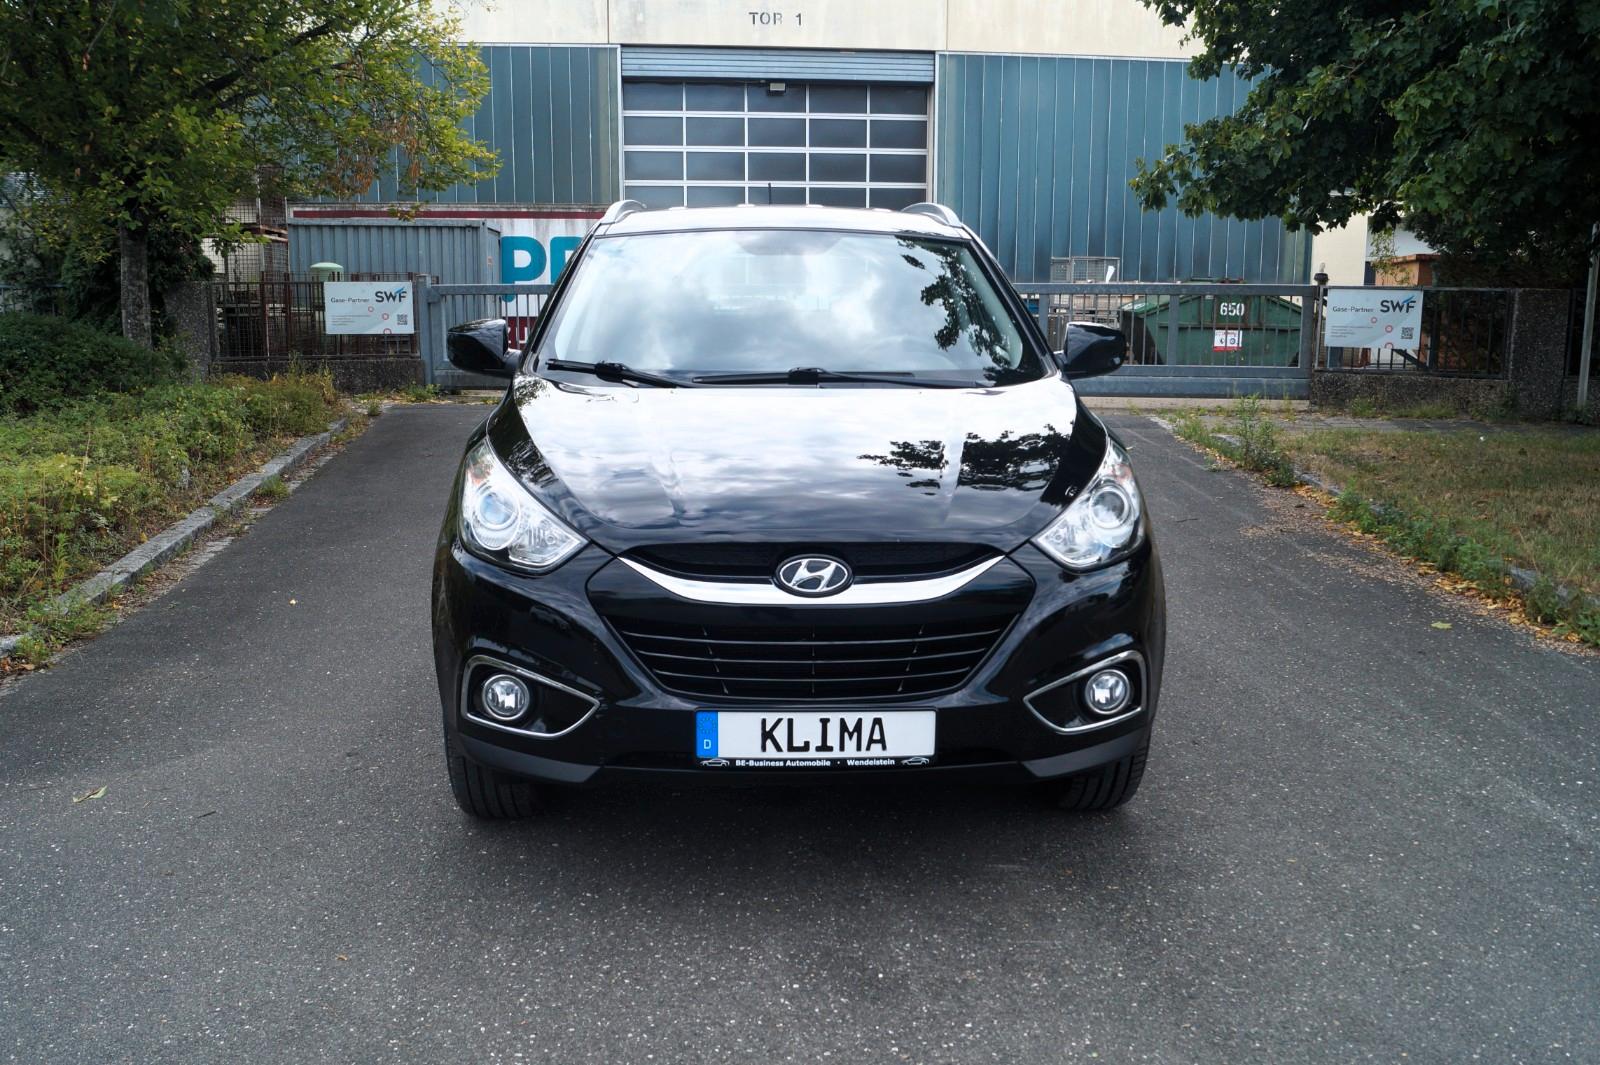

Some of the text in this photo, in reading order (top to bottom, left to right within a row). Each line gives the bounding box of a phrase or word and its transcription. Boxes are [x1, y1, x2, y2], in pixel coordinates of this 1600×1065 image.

[748, 11, 802, 26] TOR 1
[375, 289, 407, 303] SWF
[1219, 302, 1245, 317] 650
[1332, 305, 1374, 313] Gase-Partner
[1379, 298, 1416, 314] SWF
[760, 717, 887, 753] KLIMA
[703, 739, 712, 750] D
[735, 758, 896, 767] BE-Business Automobile Wendelstein
